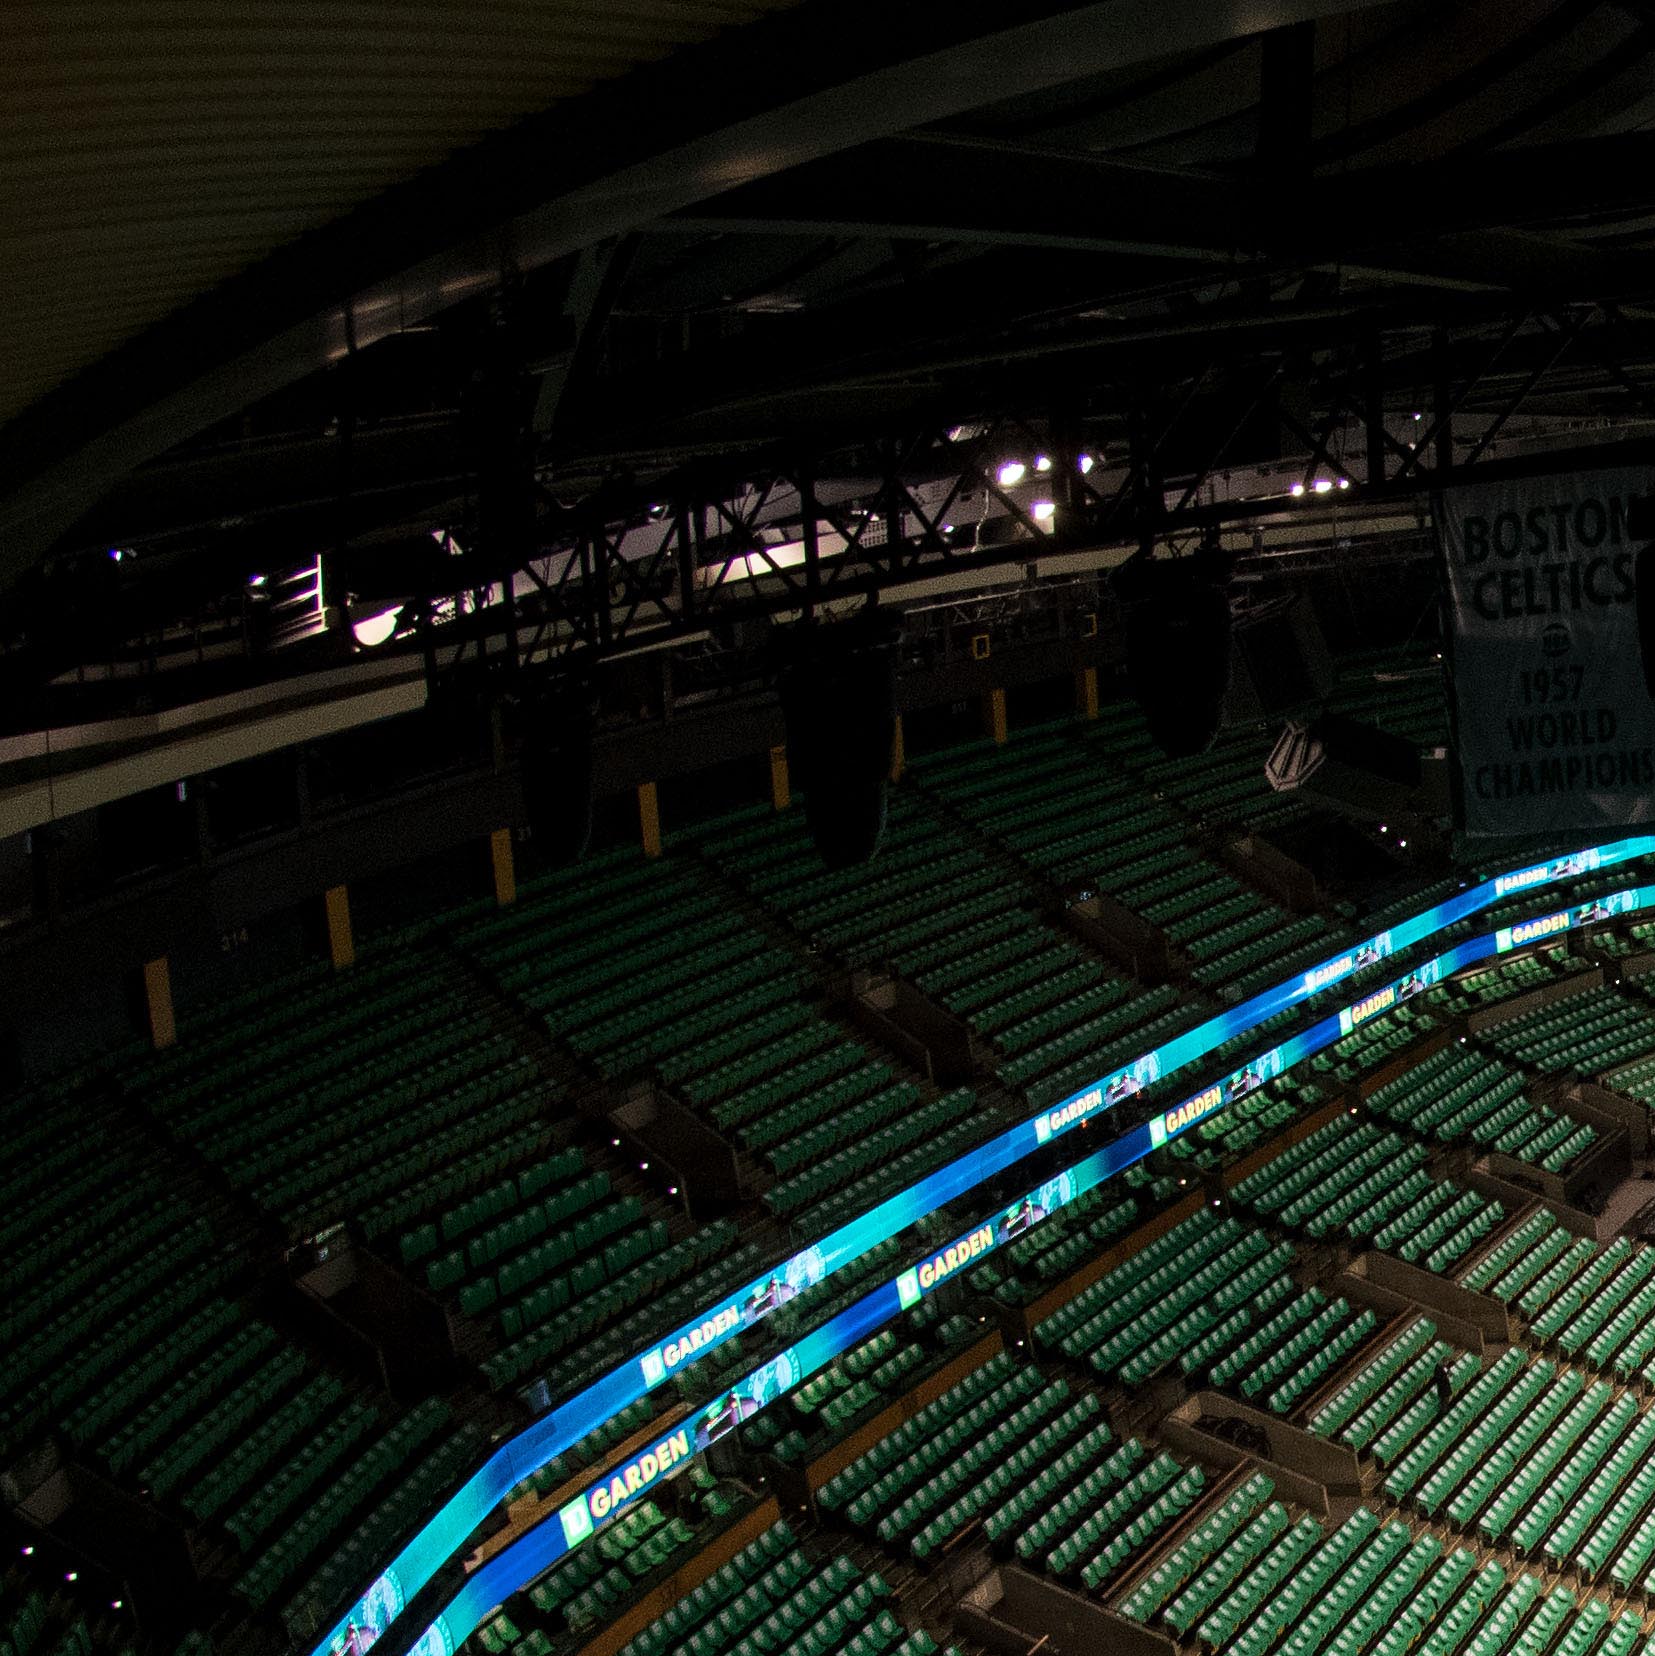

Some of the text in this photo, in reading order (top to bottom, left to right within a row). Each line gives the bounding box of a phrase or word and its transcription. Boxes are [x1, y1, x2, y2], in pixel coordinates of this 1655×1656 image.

[1464, 498, 1636, 563] BOSTON
[1474, 554, 1636, 620] CELTICS
[1520, 666, 1584, 702] 1957
[1506, 709, 1617, 750] WORLD
[1475, 751, 1654, 798] CHAMPIONS
[1504, 868, 1548, 891] GARDEN
[1512, 913, 1570, 943] GARDEN
[1352, 987, 1394, 1024] GARDEN
[1050, 1089, 1102, 1131] GARDEN
[1166, 1085, 1222, 1133] GARDEN
[918, 1225, 994, 1288] GARDEN
[662, 1305, 739, 1368] GARDEN
[589, 1429, 689, 1519] GARDEN
